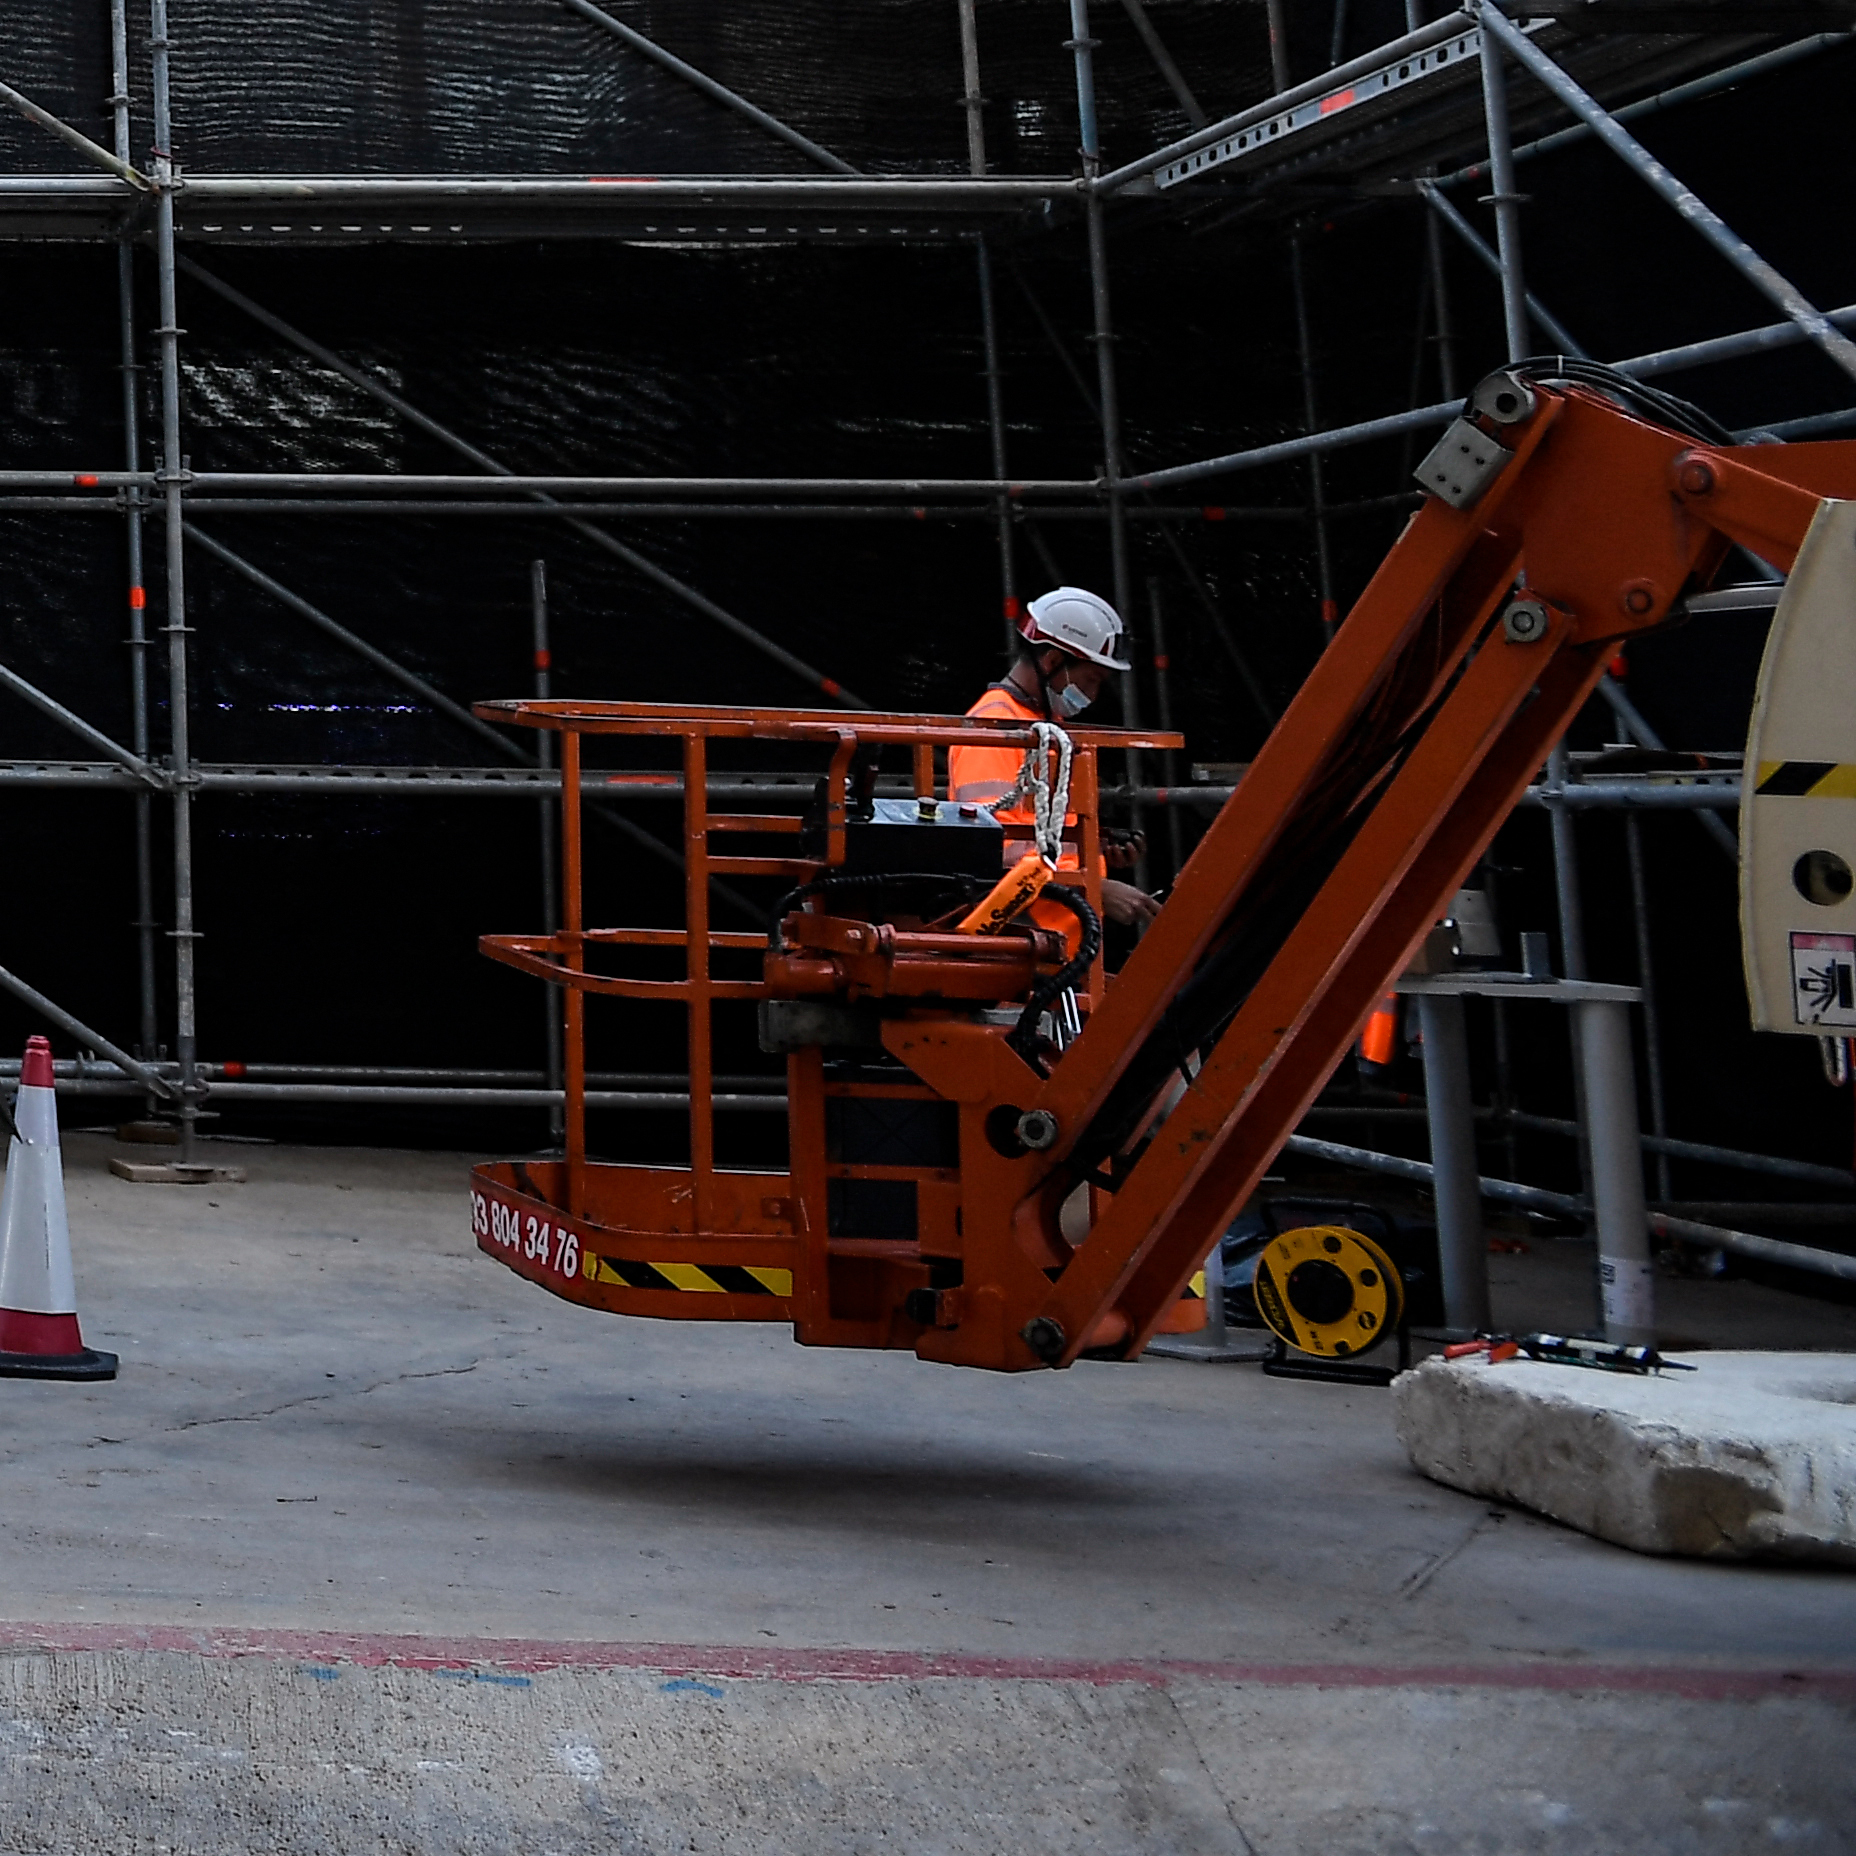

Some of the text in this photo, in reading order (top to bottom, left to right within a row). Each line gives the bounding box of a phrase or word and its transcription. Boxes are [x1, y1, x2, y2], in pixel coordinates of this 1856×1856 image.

[491, 1200, 520, 1253] 804
[524, 1216, 550, 1265] 34
[554, 1227, 580, 1278] 76
